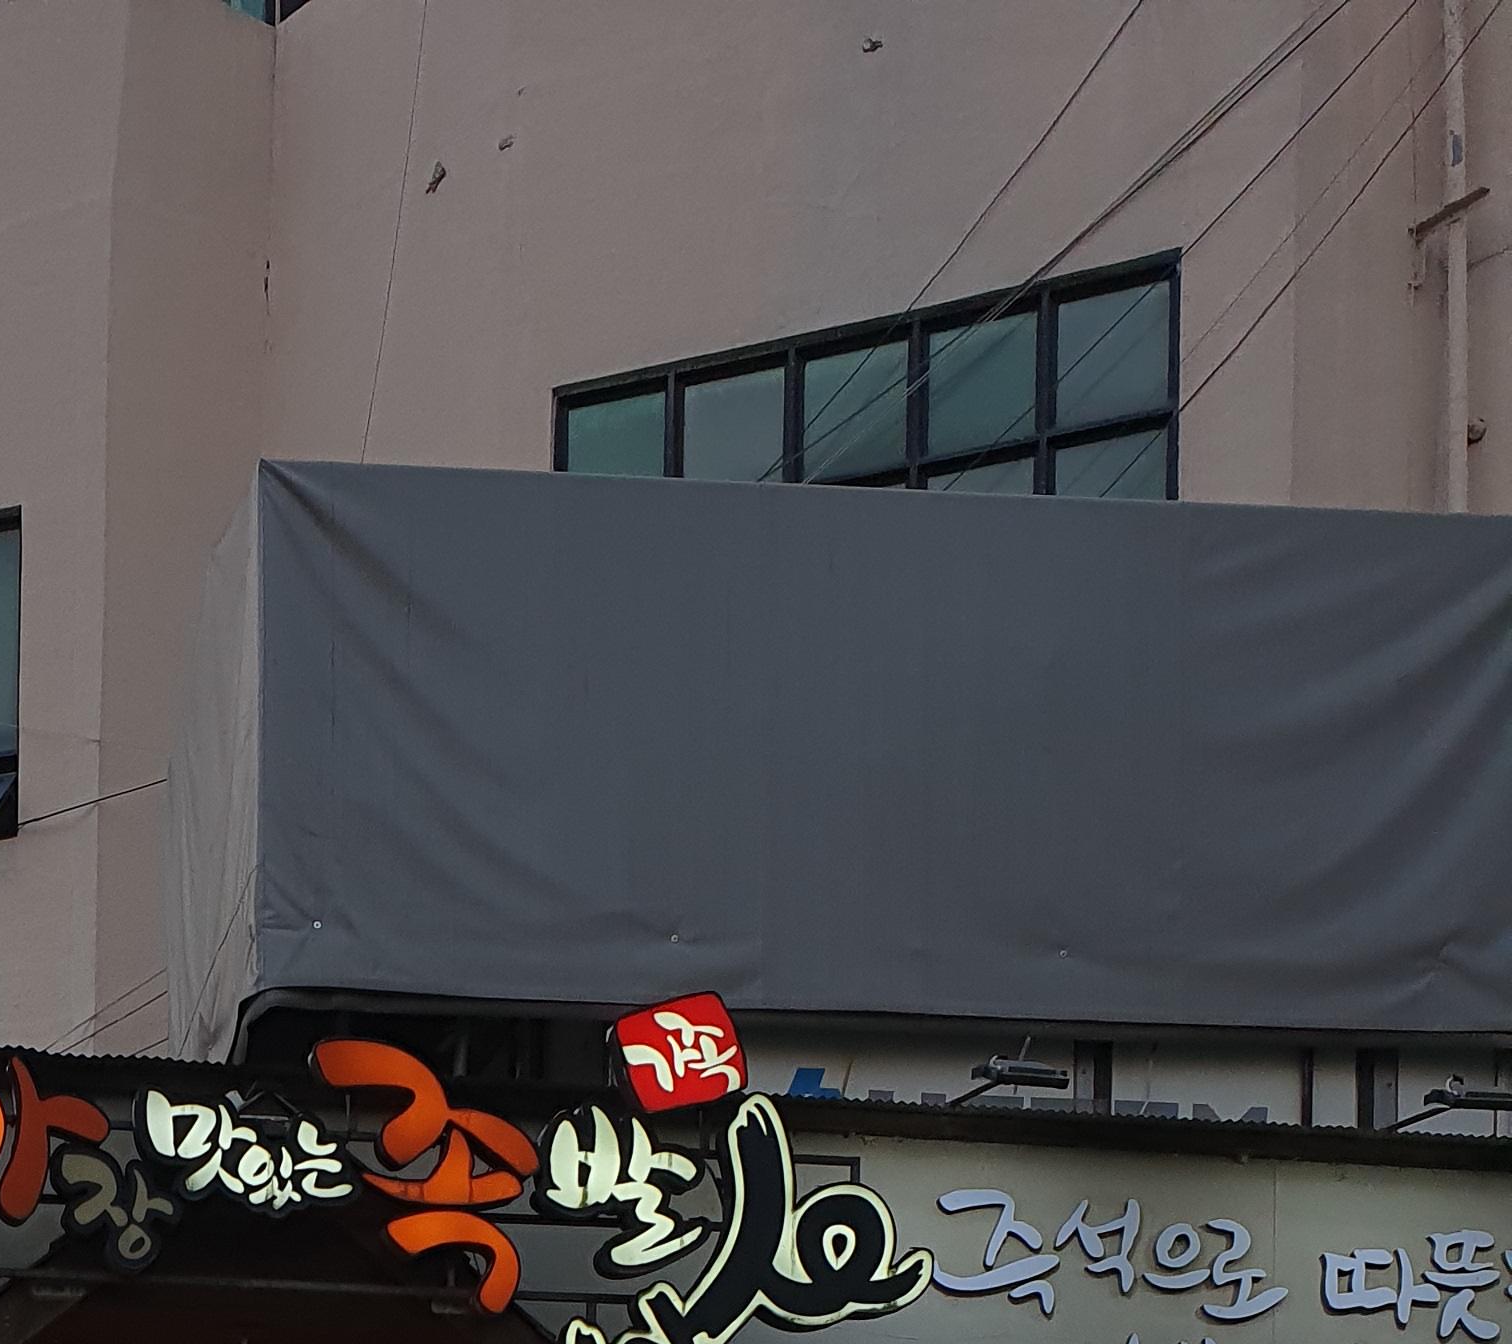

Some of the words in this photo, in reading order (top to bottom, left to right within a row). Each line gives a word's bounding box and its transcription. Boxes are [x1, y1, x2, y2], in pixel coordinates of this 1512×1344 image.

[622, 1011, 741, 1094] 가족
[147, 1091, 355, 1209] 맛있는
[313, 1038, 702, 1313] 족발
[933, 1188, 1288, 1321] 즉석으로
[1321, 1228, 1512, 1342] 따뜻
